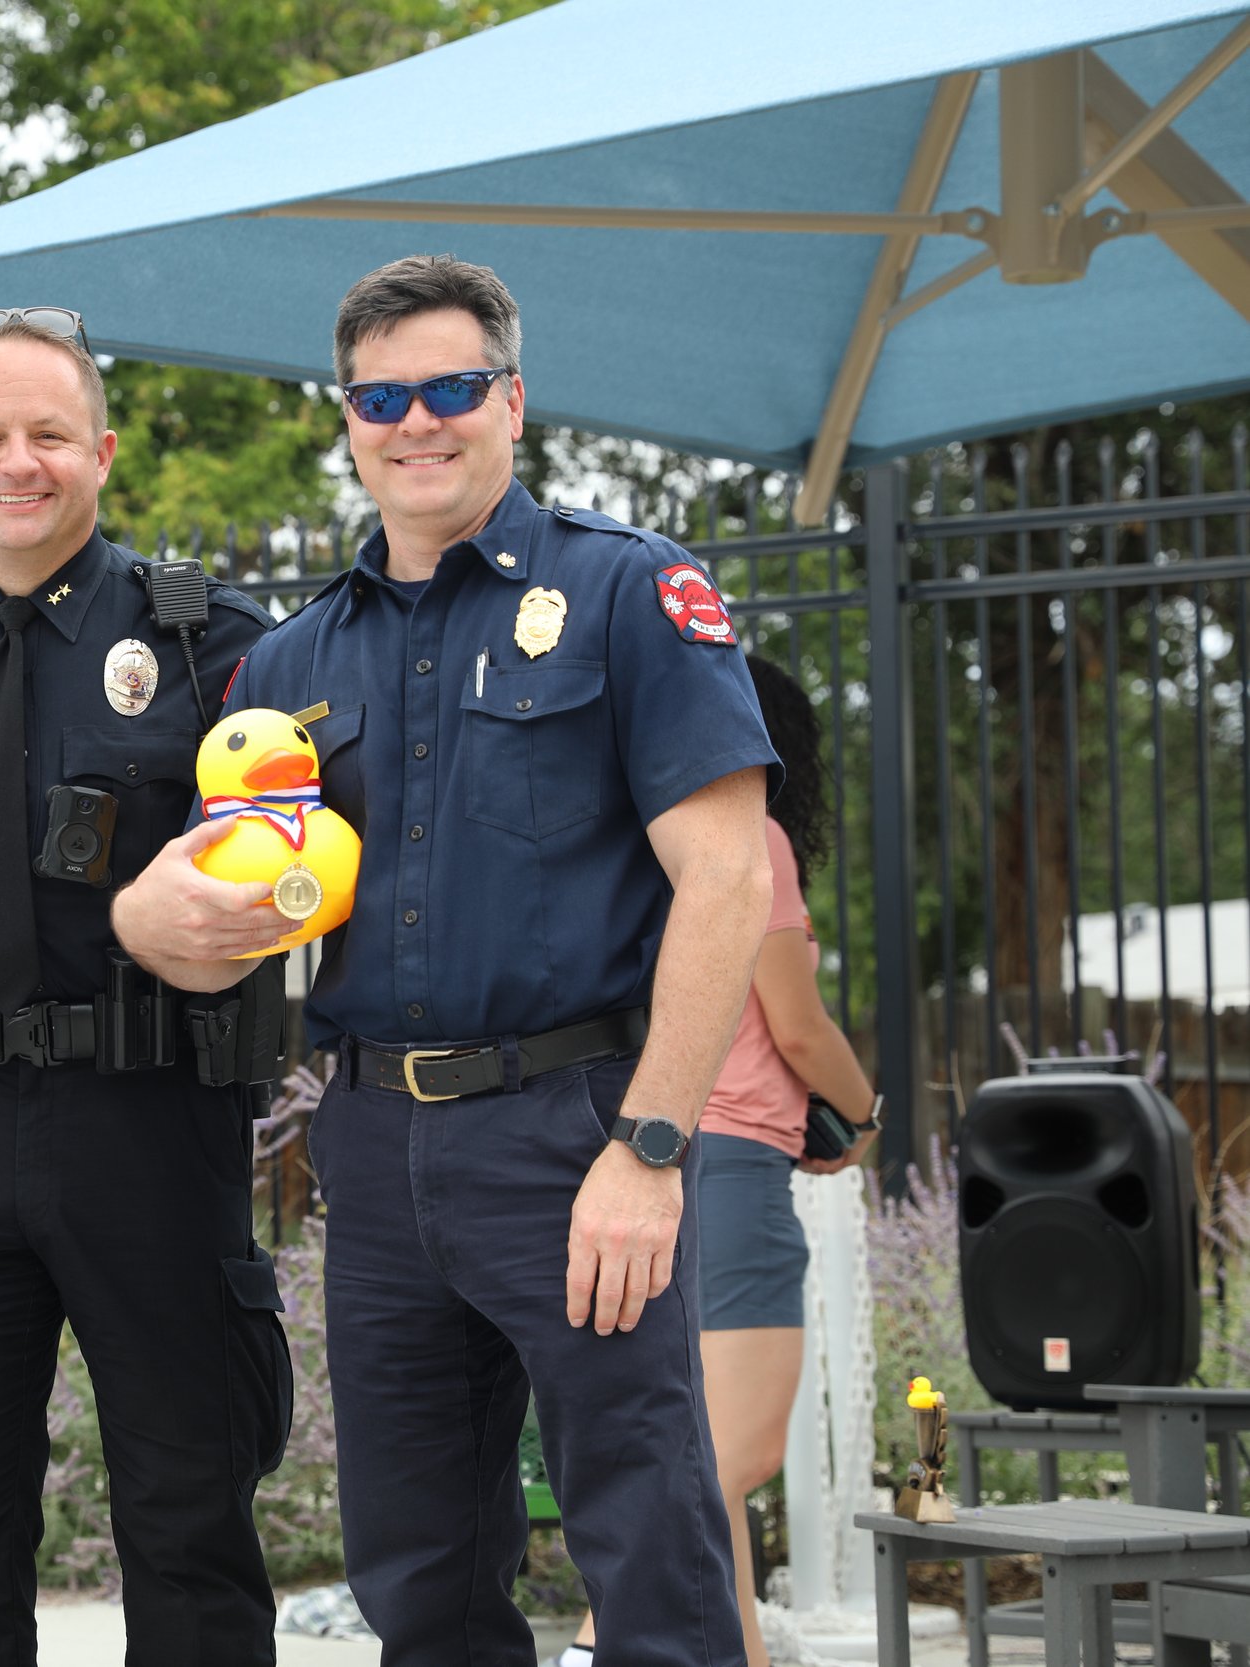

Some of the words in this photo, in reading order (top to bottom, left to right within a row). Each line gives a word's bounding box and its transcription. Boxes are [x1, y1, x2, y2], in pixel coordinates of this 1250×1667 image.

[163, 565, 187, 574] HARRIS
[692, 621, 711, 633] FIRE
[290, 881, 307, 905] 1
